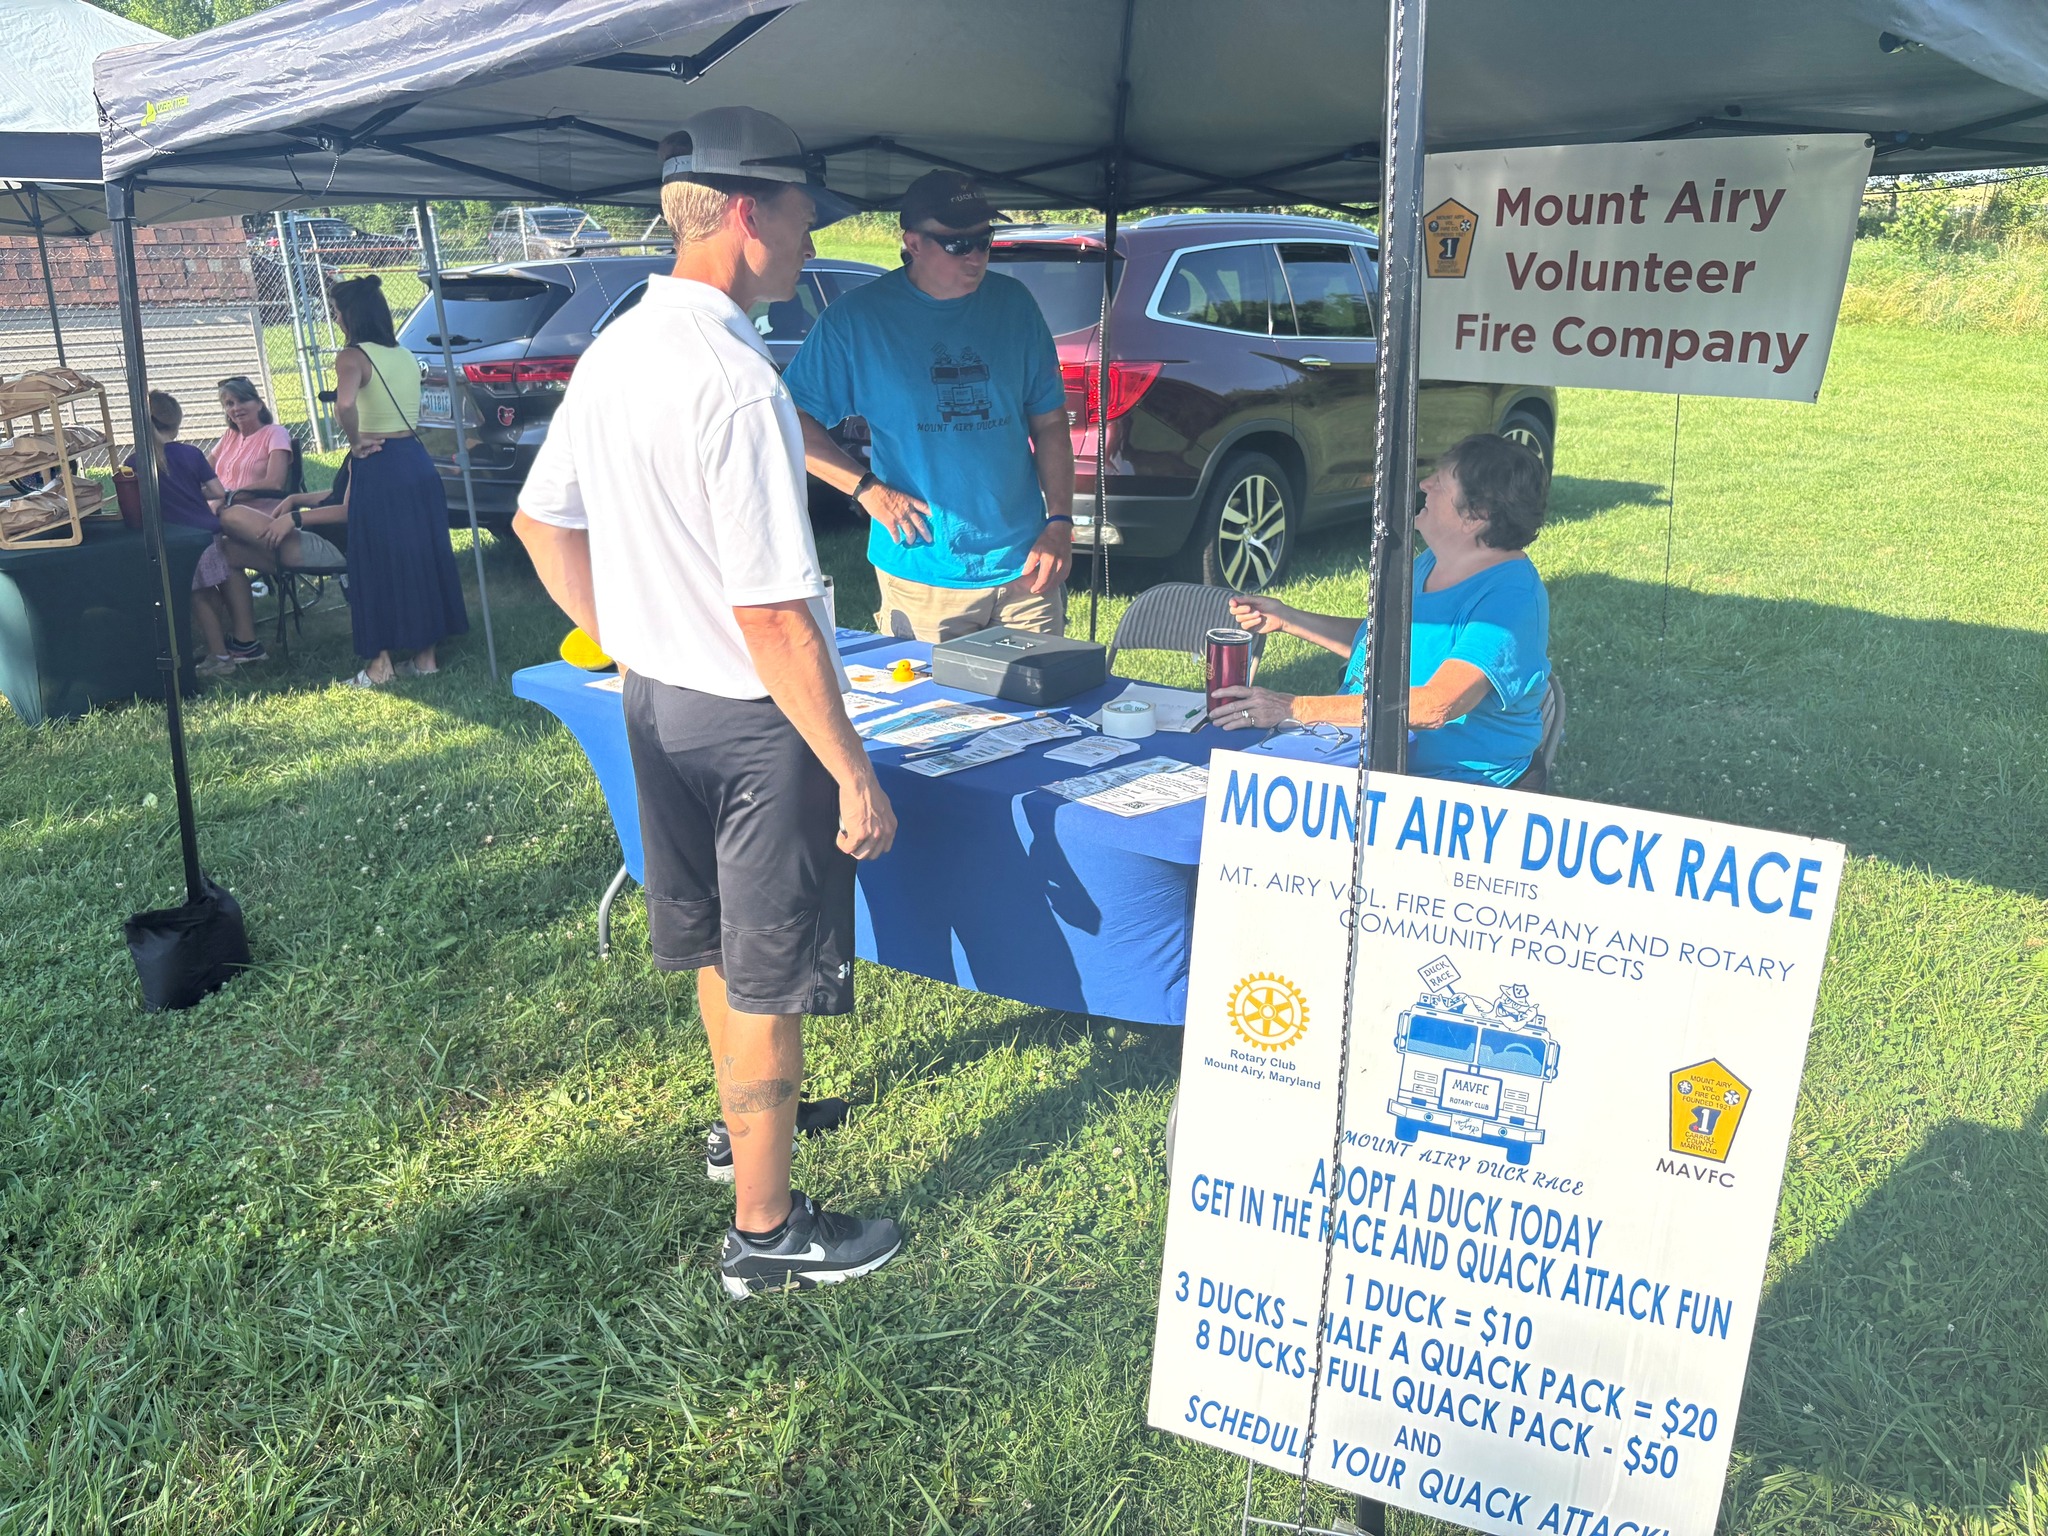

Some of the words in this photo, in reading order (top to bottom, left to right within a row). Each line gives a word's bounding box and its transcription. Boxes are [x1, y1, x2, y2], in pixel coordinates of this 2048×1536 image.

[1496, 184, 1648, 227] Mount
[1664, 178, 1787, 232] Airy
[1505, 250, 1756, 294] Volunteer
[1456, 313, 1536, 354] Fire
[1552, 316, 1810, 374] Company
[917, 423, 950, 432] MOUNT
[1220, 769, 1387, 846] MOUNT
[1395, 795, 1509, 865] AIRY
[1520, 814, 1664, 894] DUCK
[1675, 837, 1823, 921] RACE
[1453, 872, 1538, 901] BENEFITS
[1220, 864, 1258, 888] MT.
[1266, 872, 1321, 897] AIRY
[1330, 881, 1386, 909] VOL.
[1397, 892, 1447, 920] FIRE
[1453, 902, 1599, 946] COMPANY
[1606, 930, 1669, 958] AND
[1679, 943, 1795, 982] ROTARY
[1340, 909, 1503, 954] COMMUNITY
[1510, 937, 1645, 981] PROJECTS
[1423, 961, 1450, 978] DUCK
[1429, 971, 1454, 987] RACE
[1204, 1057, 1238, 1072] Mount
[1240, 1065, 1265, 1080] Airy,
[1269, 1071, 1321, 1090] Maryland
[1230, 1049, 1267, 1067] Rotary
[1270, 1057, 1296, 1071] Club
[1452, 1079, 1490, 1096] MAVFC
[1690, 1075, 1715, 1086] MOUNT
[1715, 1080, 1732, 1089] AIRY
[1694, 1091, 1709, 1100] FIRE
[1710, 1094, 1722, 1102] CO.
[1702, 1085, 1717, 1093] VOL.
[1449, 1097, 1474, 1107] ROTARY
[1474, 1101, 1490, 1111] CLUB
[1682, 1096, 1714, 1107] FOUNDED
[1716, 1103, 1732, 1111] 1921
[1698, 1108, 1710, 1133] 1
[1341, 1130, 1413, 1157] MOUNT
[1418, 1150, 1471, 1171] AIRY
[1476, 1159, 1529, 1184] DUCK
[1532, 1171, 1584, 1196] RACE
[1680, 1142, 1718, 1155] MARYLAND
[1656, 1158, 1735, 1188] MAVFC
[1309, 1158, 1396, 1212] ADOPT
[1399, 1178, 1418, 1220] A
[1427, 1183, 1503, 1238] DUCK
[1509, 1201, 1603, 1259] TODAY
[1191, 1173, 1235, 1219] GET
[1239, 1185, 1265, 1227] IN
[1272, 1192, 1313, 1240] THE
[1318, 1205, 1386, 1258] RACE
[1390, 1223, 1449, 1271] AND
[1457, 1238, 1556, 1299] QUACK
[1560, 1265, 1670, 1325] ATTACK
[1676, 1287, 1733, 1341] FUN
[1345, 1273, 1355, 1306] 1
[1365, 1278, 1447, 1329] DUCK
[1454, 1309, 1472, 1327] =
[1480, 1305, 1533, 1351] $10
[1175, 1271, 1190, 1302] 3
[1198, 1277, 1286, 1330] DUCKS
[1389, 1331, 1410, 1365] A
[1421, 1340, 1531, 1396] QUACK
[1539, 1366, 1626, 1421] PACK
[1634, 1400, 1653, 1418] =
[1661, 1396, 1718, 1443] $20
[1195, 1319, 1211, 1350] 8
[1326, 1355, 1382, 1402] FULL
[1392, 1375, 1501, 1435] QUACK
[1508, 1406, 1595, 1459] PACK
[1623, 1435, 1680, 1480] $50
[1393, 1425, 1443, 1458] AND
[1331, 1439, 1406, 1490] YOUR
[1418, 1467, 1532, 1525] QUACK
